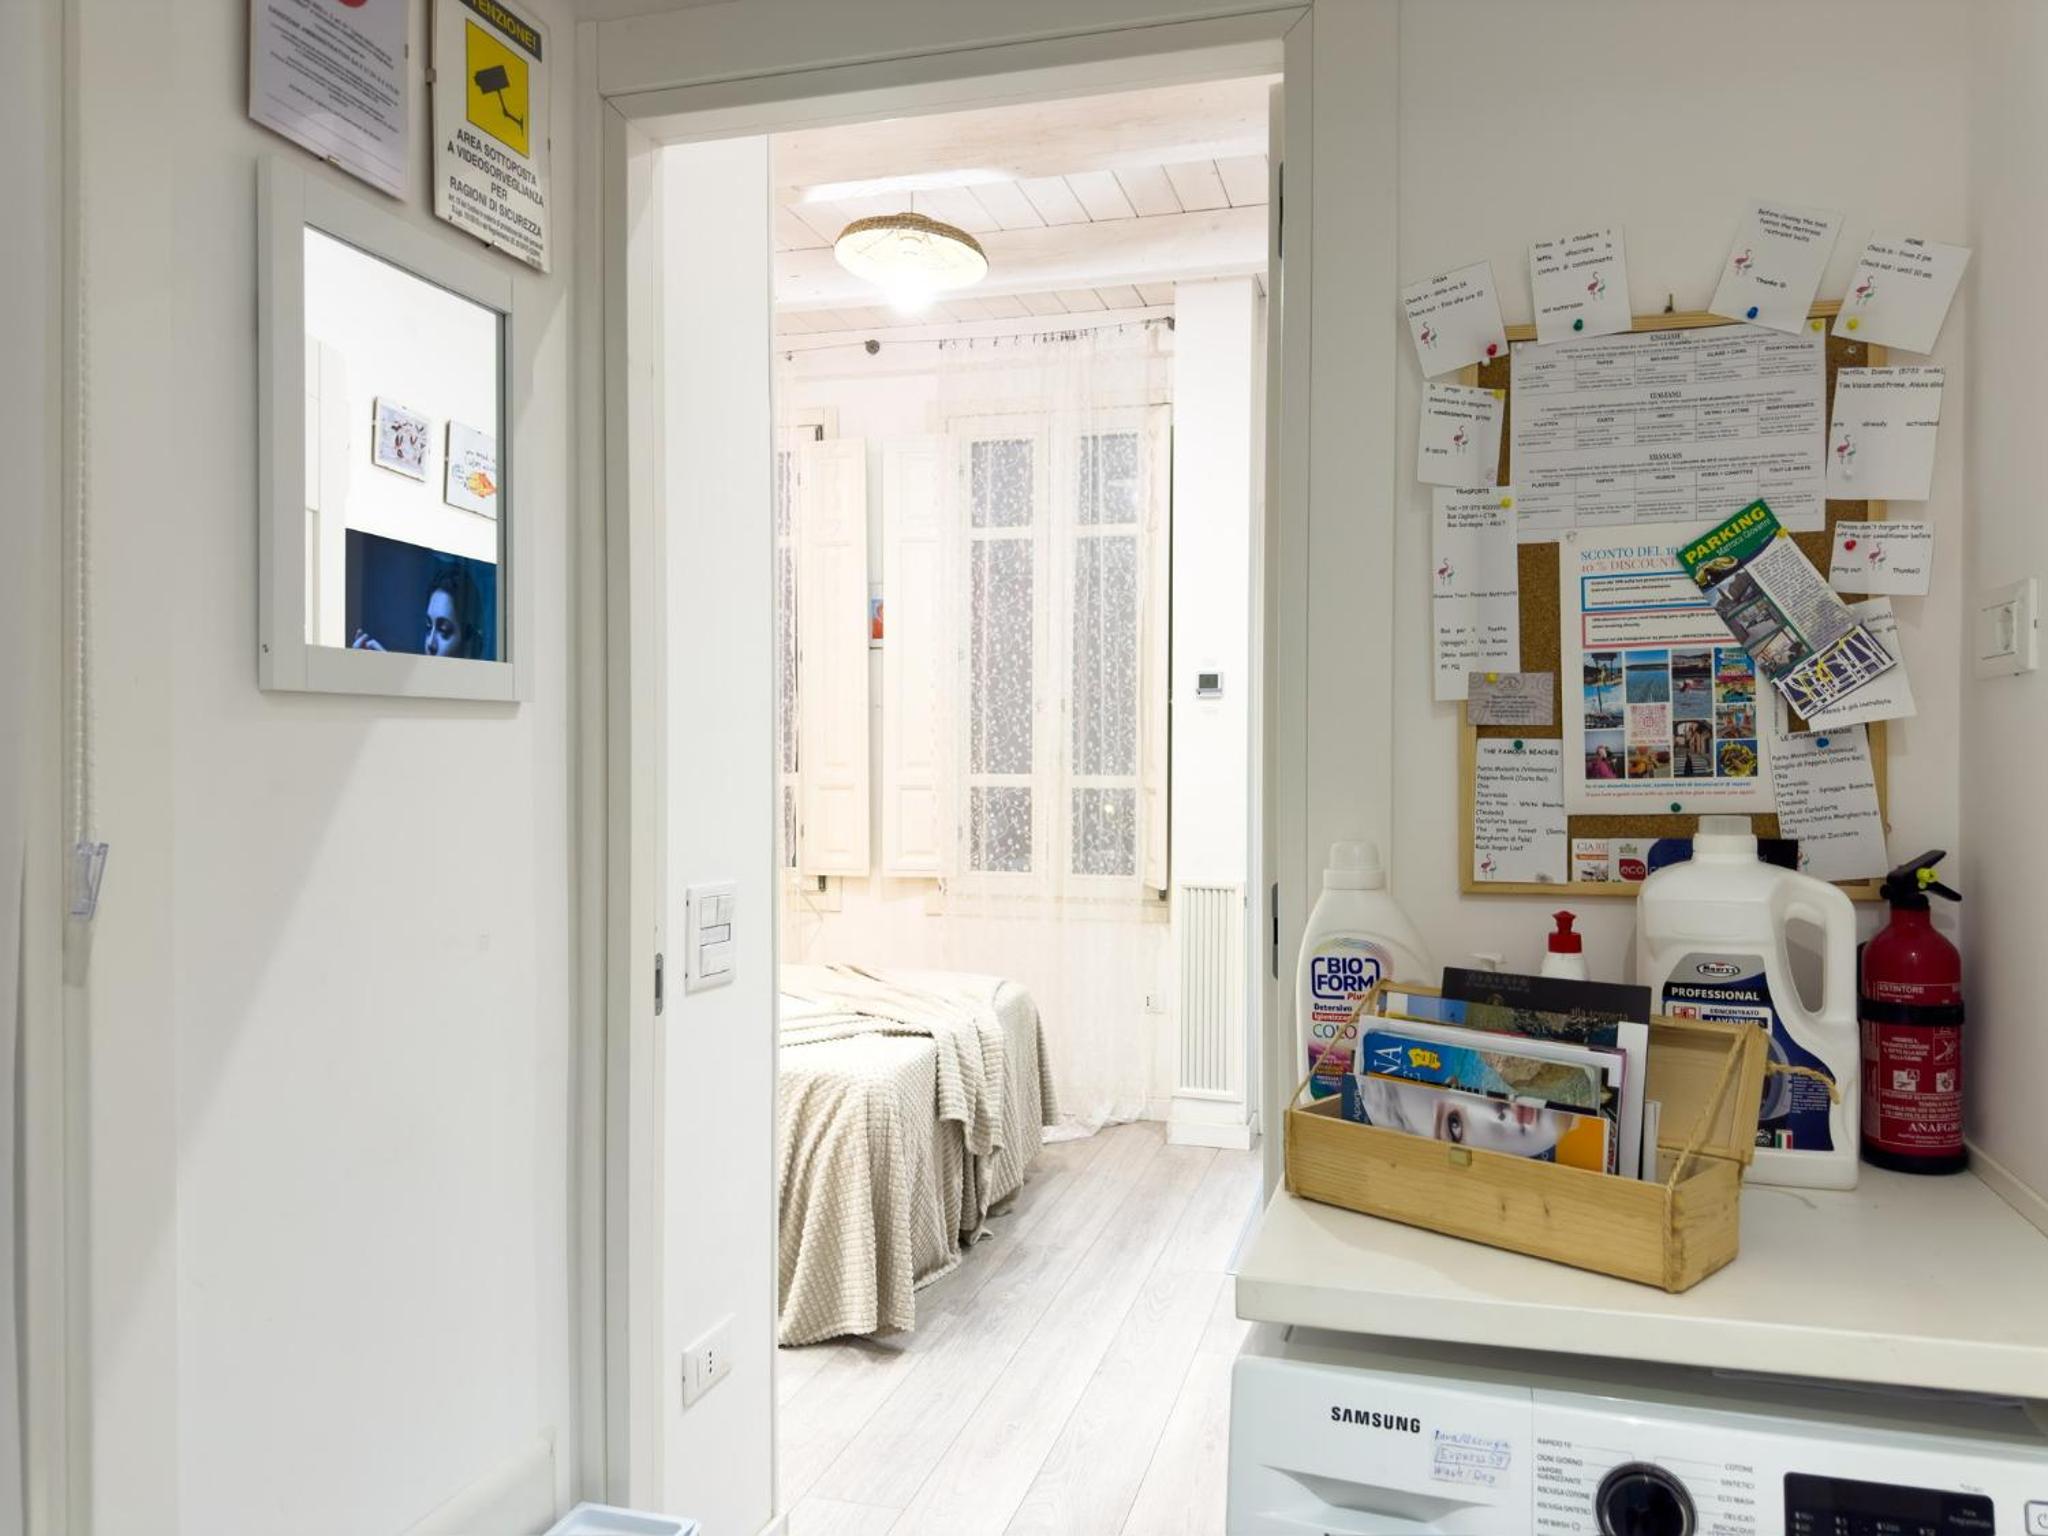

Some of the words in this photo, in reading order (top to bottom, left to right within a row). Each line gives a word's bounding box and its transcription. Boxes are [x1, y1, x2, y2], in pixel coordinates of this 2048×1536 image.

[457, 128, 483, 152] AREA
[484, 144, 537, 186] SOTTOPOSTA
[447, 140, 454, 154] A
[456, 144, 544, 208] VIDEOSORVEGLIANZA
[491, 182, 507, 200] PER
[449, 176, 487, 206] RAGIONI
[489, 199, 497, 212] DI
[499, 203, 542, 239] SICUREZZA
[1684, 507, 1767, 565] PARKING
[1873, 531, 1909, 539] conditioner
[1581, 549, 1635, 562] SCONTO
[1637, 546, 1660, 558] DEL
[1610, 555, 1682, 572] DISCOUNT
[1529, 748, 1560, 756] BEACHES
[1621, 865, 1646, 876] eco
[1327, 957, 1363, 975] BIO
[1317, 974, 1374, 993] FORM
[1878, 983, 1926, 995] ESTINTORE
[1671, 986, 1761, 1002] PROFESSIONAL
[1314, 1002, 1353, 1013] Detersivo
[1709, 1008, 1761, 1017] CONCENTRATO
[1331, 1405, 1422, 1435] SAMSUNG
[1537, 1438, 1562, 1448] RAPIDO
[1537, 1454, 1554, 1462] OGNI
[1555, 1456, 1583, 1467] GIORNO
[1537, 1466, 1563, 1475] VAPORE
[1725, 1463, 1753, 1473] COTONE
[1537, 1473, 1581, 1485] IGIENIZZANTE
[1720, 1478, 1756, 1489] SINTETICI
[1565, 1490, 1590, 1501] COTONE
[1723, 1512, 1756, 1522] DELICATI
